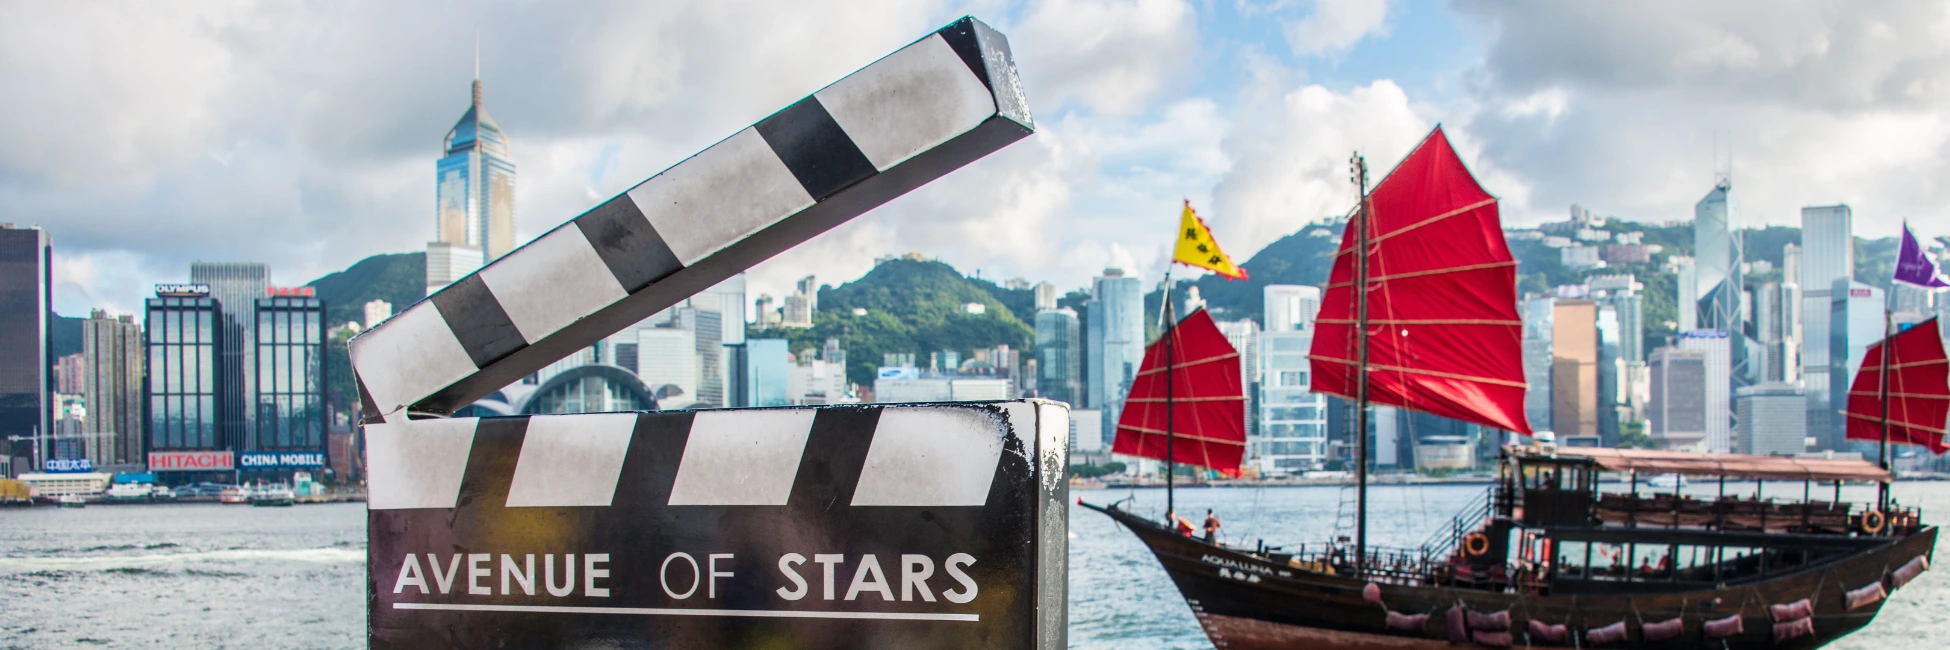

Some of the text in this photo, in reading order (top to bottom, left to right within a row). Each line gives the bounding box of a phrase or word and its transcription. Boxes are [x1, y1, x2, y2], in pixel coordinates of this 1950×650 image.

[155, 284, 209, 294] OLYMPUS
[150, 453, 233, 468] HITACHI
[241, 453, 323, 466] CHINA MOBILE
[1202, 554, 1238, 567] AQUA
[393, 551, 979, 604] AVENUE OF STARS
